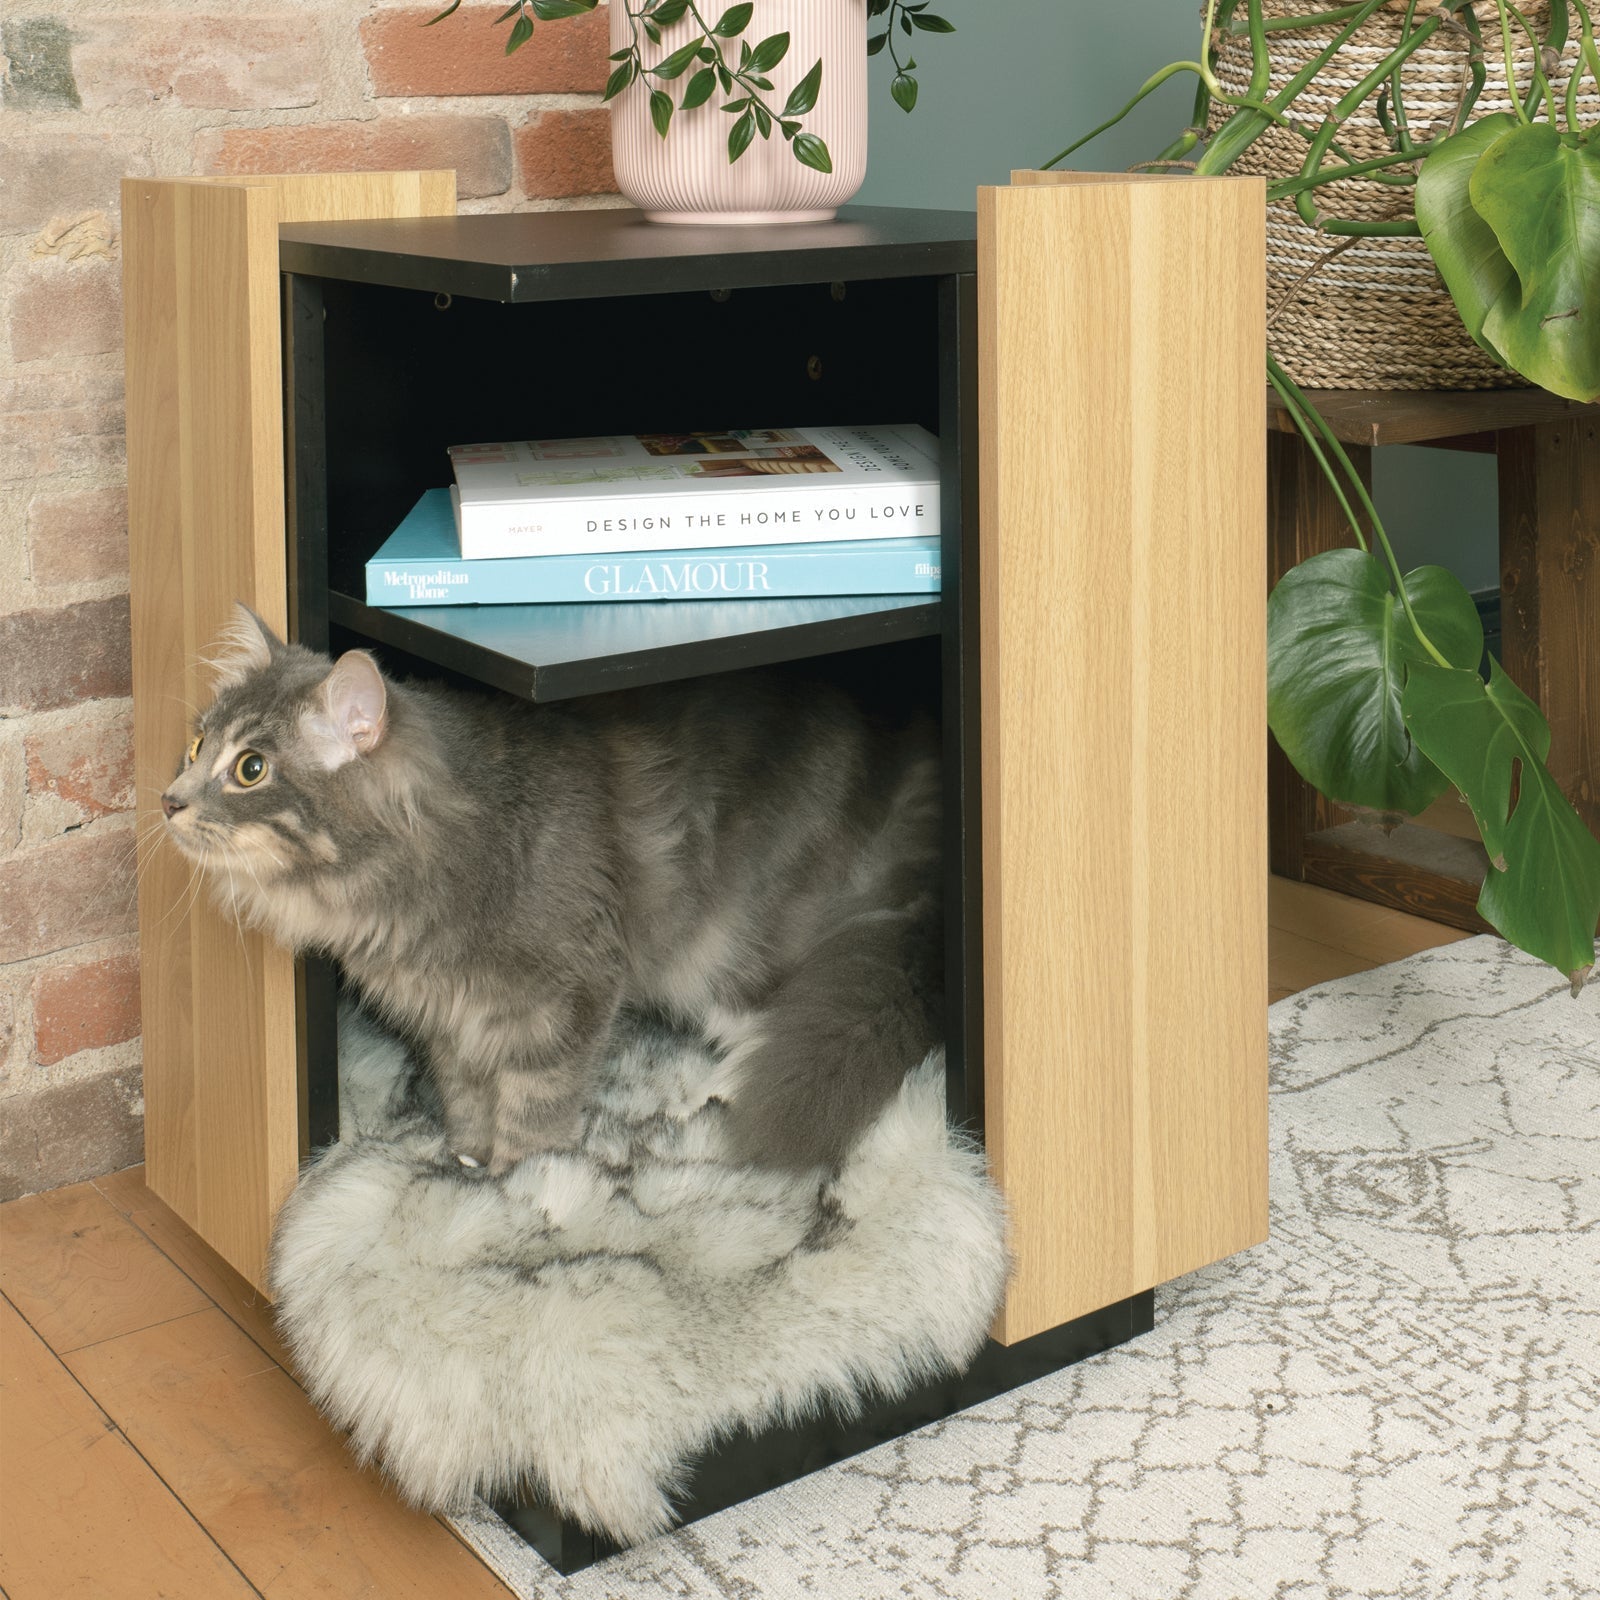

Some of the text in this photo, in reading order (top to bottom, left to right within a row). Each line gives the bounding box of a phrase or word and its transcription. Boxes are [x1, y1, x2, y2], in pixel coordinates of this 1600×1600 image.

[586, 504, 925, 533] DESIGN THE HOME YOU LOVE
[508, 525, 543, 534] MAYER
[384, 570, 469, 588] Metropolitan
[584, 561, 771, 595] GLAMOUR
[410, 584, 449, 599] Home
